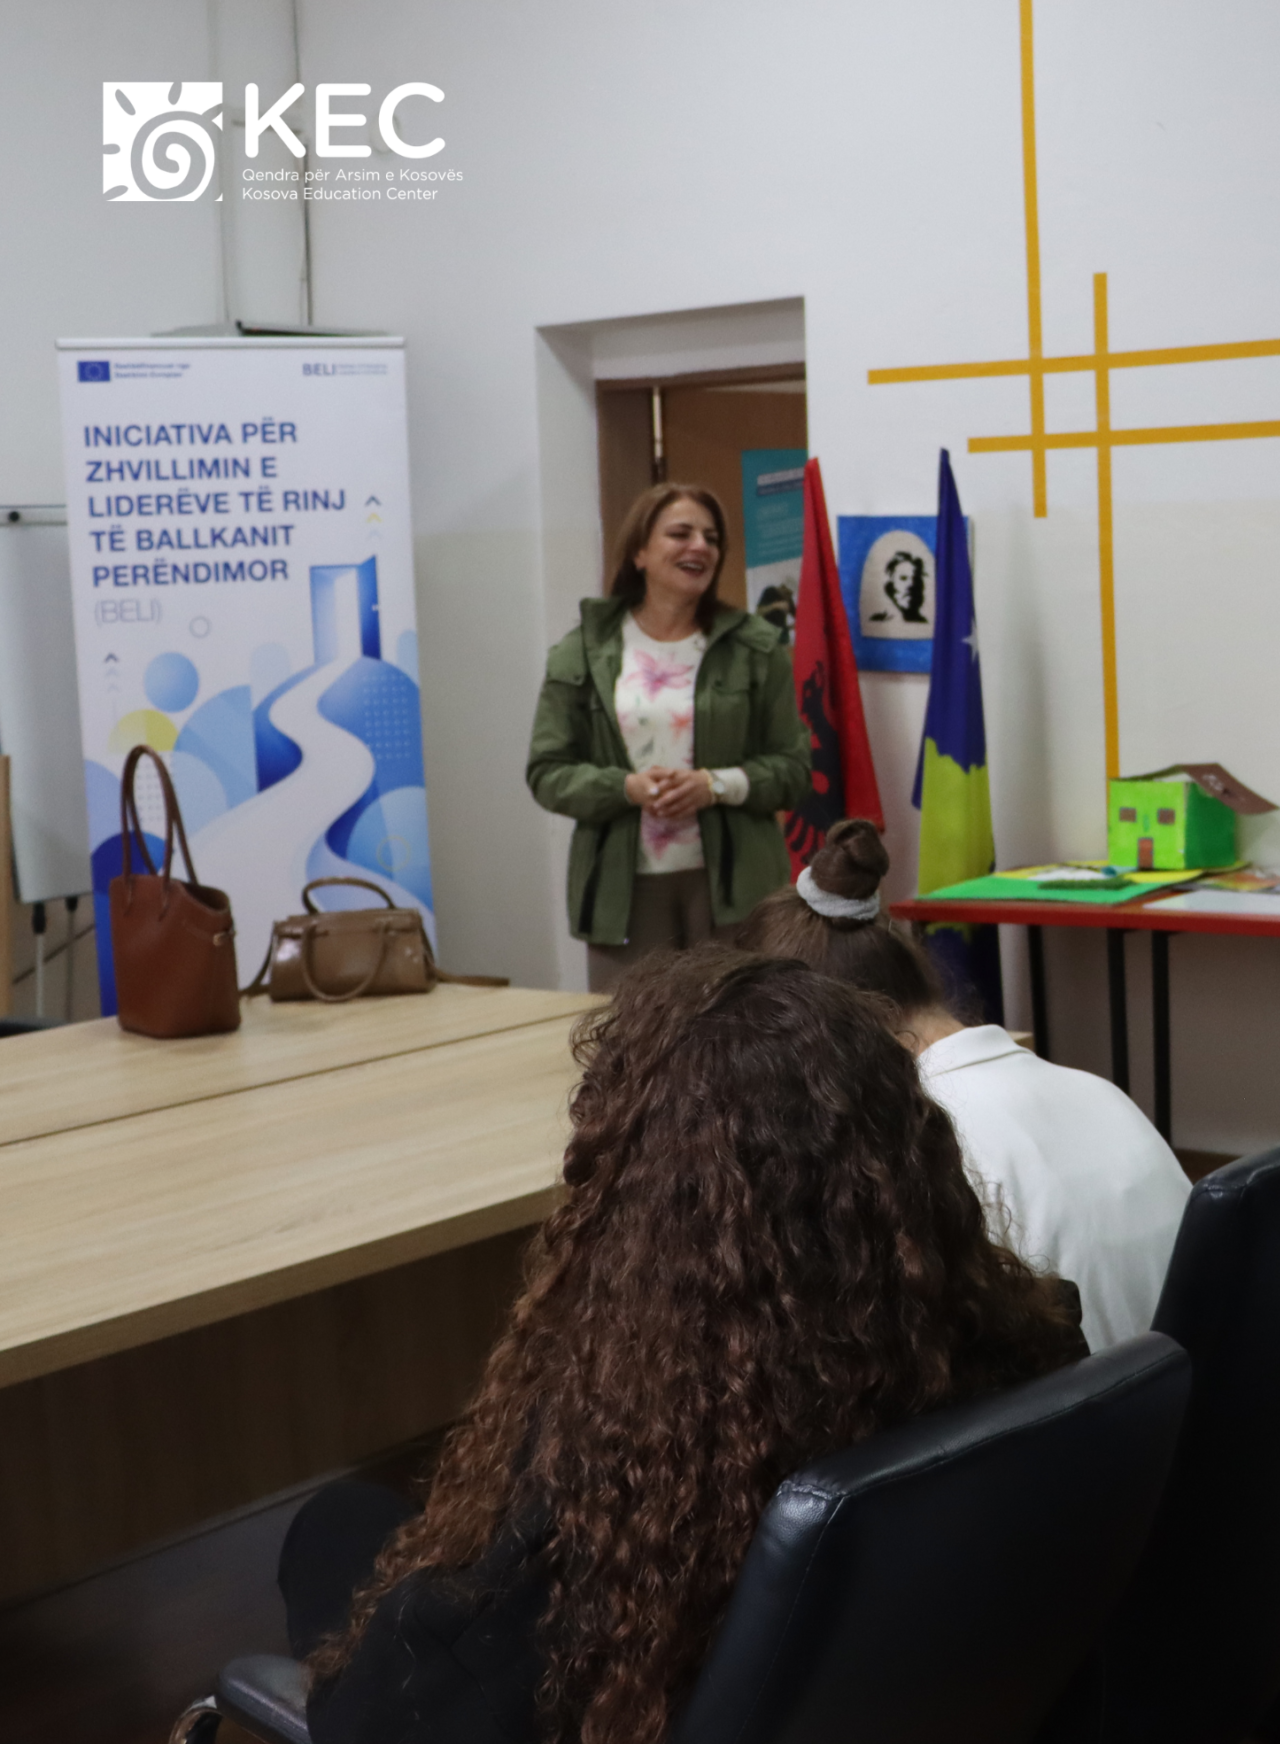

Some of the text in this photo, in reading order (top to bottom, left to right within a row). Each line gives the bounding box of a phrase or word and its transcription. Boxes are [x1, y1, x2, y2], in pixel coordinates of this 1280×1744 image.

[84, 417, 298, 448] INICIATIVA PËR
[86, 456, 278, 483] ZHVILLIMIN E
[88, 485, 347, 518] LIDERËVE TË RINJ
[89, 524, 295, 552] TË BALLKANIT
[92, 558, 289, 588] PERËNDIMOR
[95, 598, 162, 627] (BELI)
